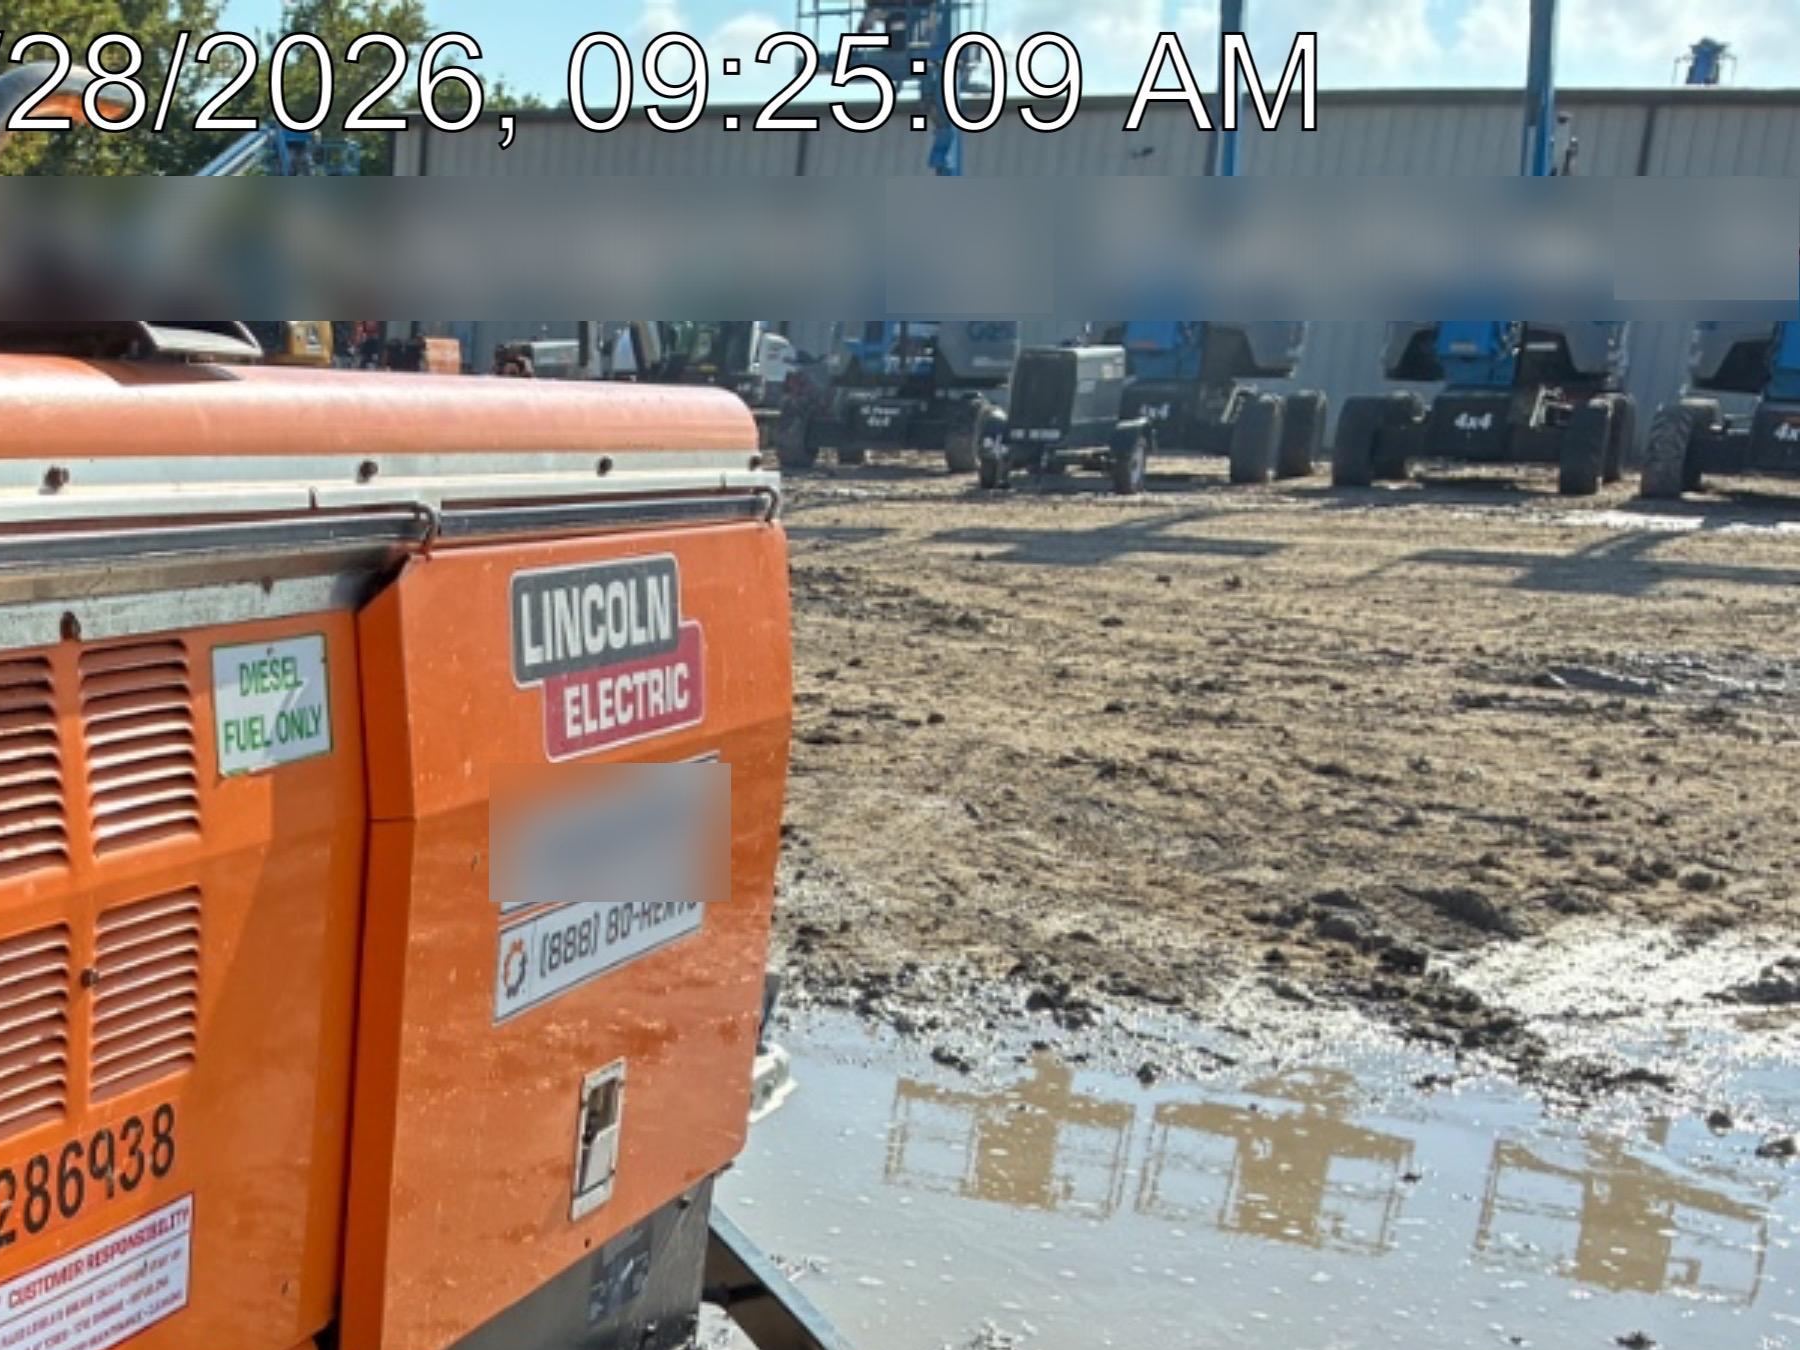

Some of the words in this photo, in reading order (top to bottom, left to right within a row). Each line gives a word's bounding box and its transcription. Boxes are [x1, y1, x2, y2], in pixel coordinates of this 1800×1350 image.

[1454, 412, 1493, 431] 4x4
[1773, 420, 1800, 440] 4x
[520, 574, 673, 666] LINCOLN
[239, 655, 304, 697] DIESEL
[563, 661, 691, 739] ELECTRIC
[224, 714, 273, 754] FUEL
[275, 703, 322, 744] ONLY
[539, 911, 600, 979] (888)
[8, 1259, 84, 1310] CUSTOMER
[86, 1207, 190, 1275] RESPONSIBILITY
